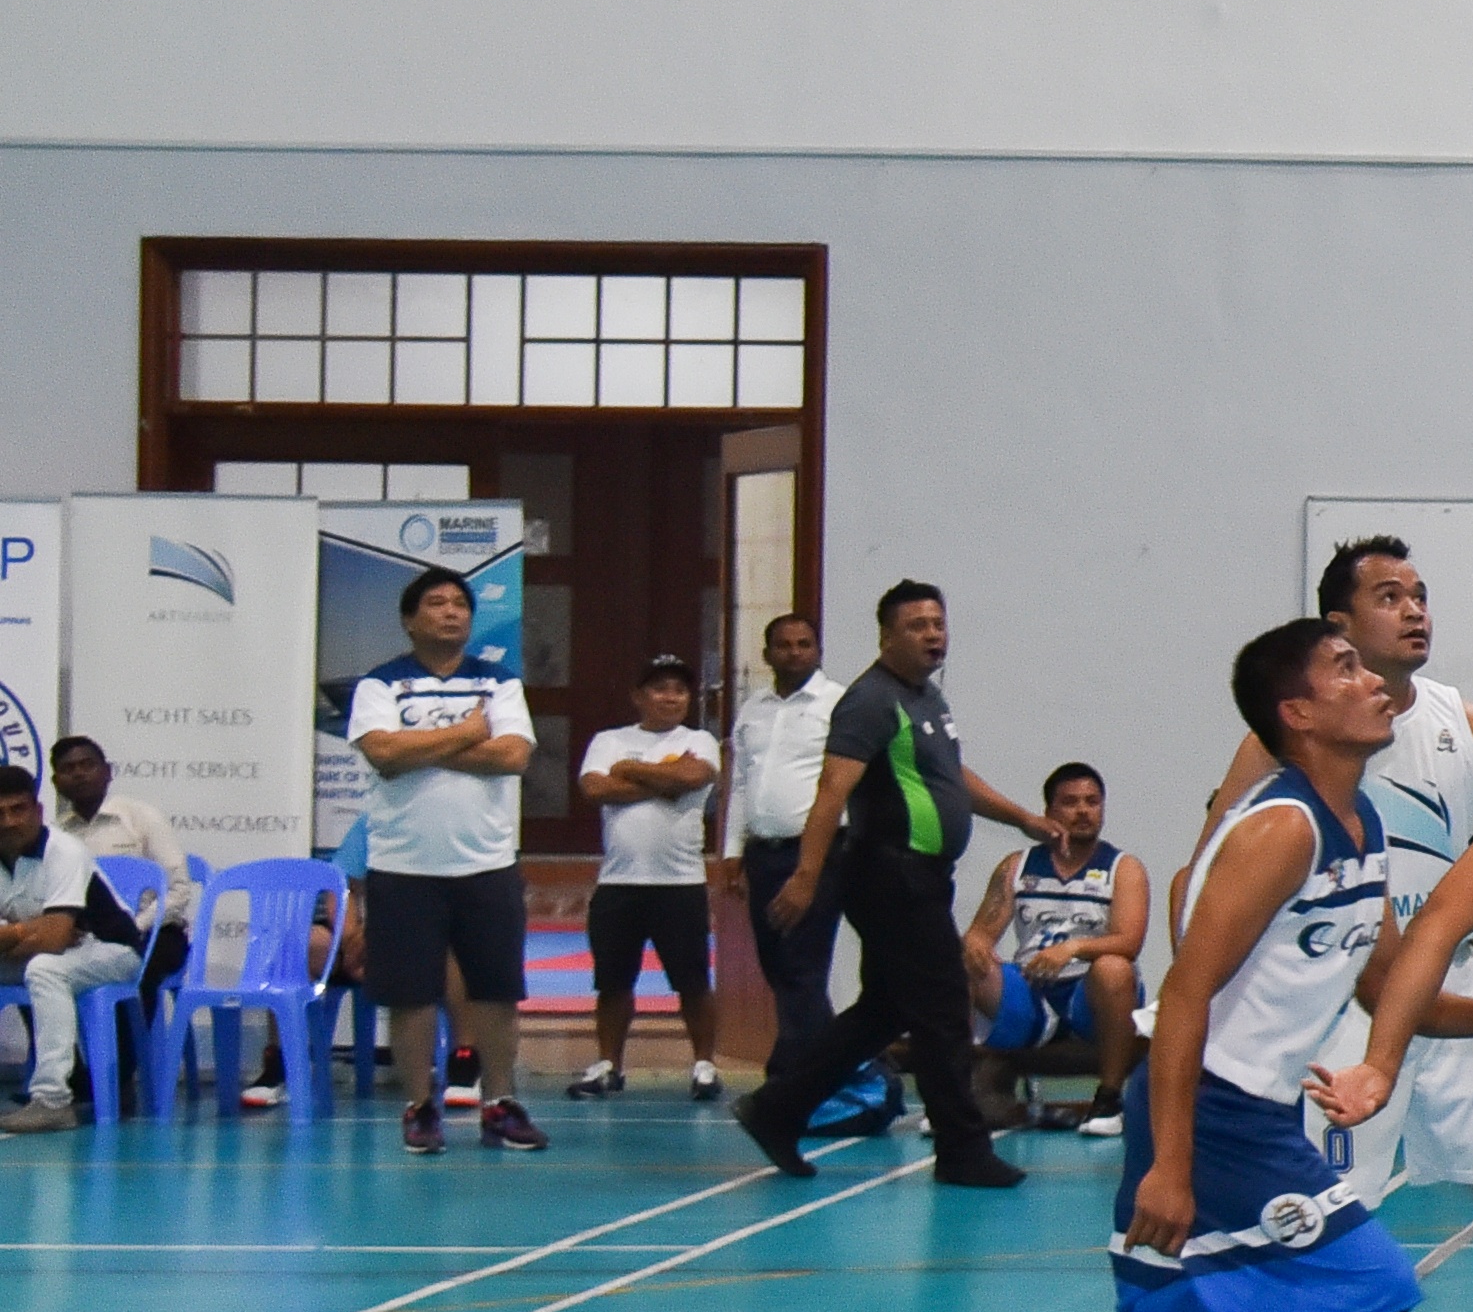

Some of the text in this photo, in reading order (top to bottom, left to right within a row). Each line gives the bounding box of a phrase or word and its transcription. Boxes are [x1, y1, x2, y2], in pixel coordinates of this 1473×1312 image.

[125, 707, 253, 726] YACHT SALES
[186, 760, 259, 779] SERVICE
